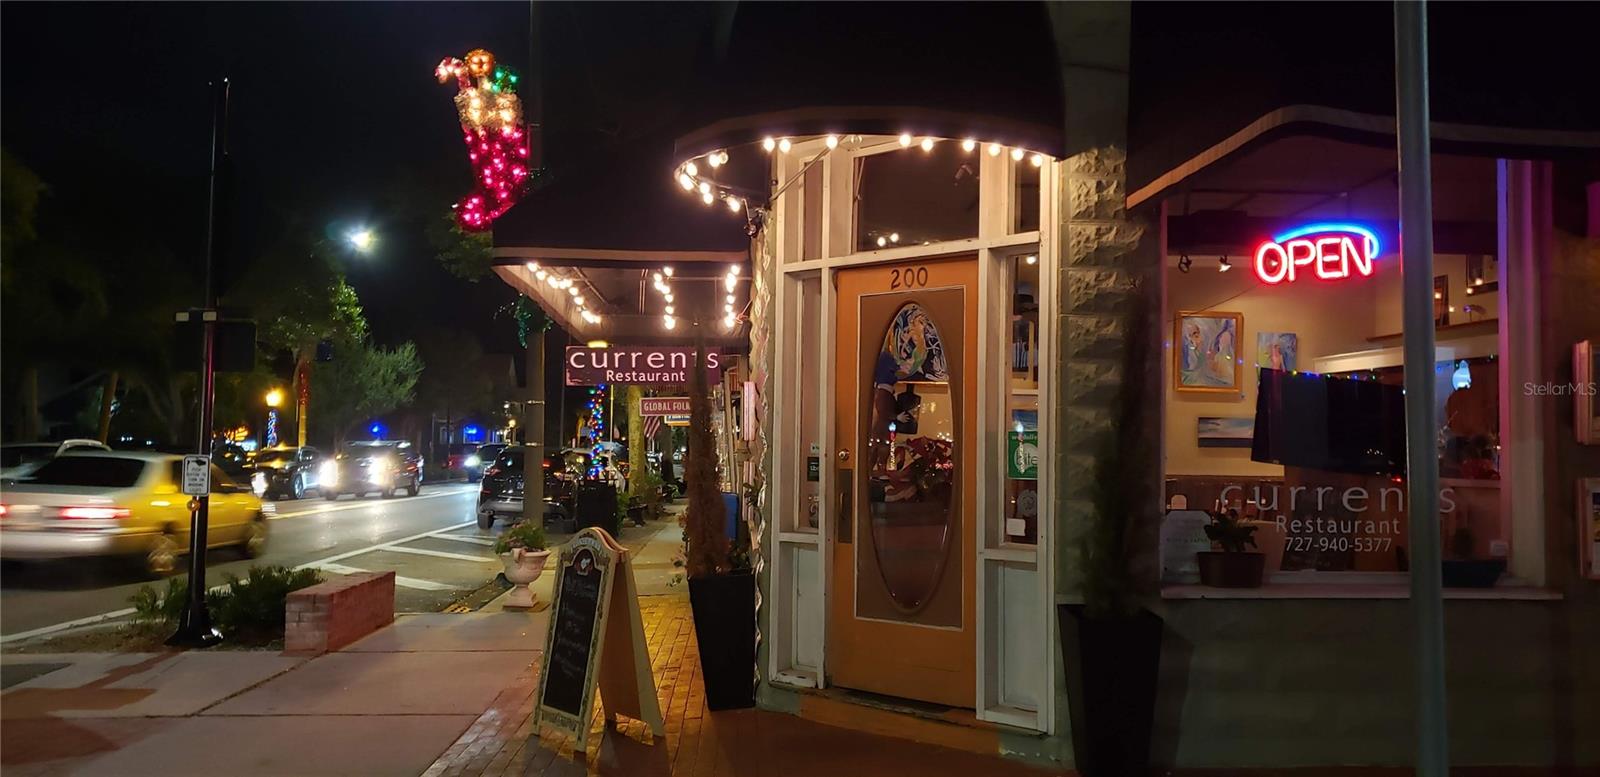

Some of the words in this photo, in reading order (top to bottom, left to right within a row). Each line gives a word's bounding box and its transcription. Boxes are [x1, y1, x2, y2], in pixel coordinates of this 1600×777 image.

[1256, 236, 1373, 283] OPEN
[891, 266, 928, 290] 200
[606, 369, 686, 382] Restaurant
[644, 402, 671, 411] GLOBAL
[1220, 485, 1456, 513] currens
[1276, 515, 1401, 535] Restaurant
[1285, 537, 1392, 553] 727-940-5377
